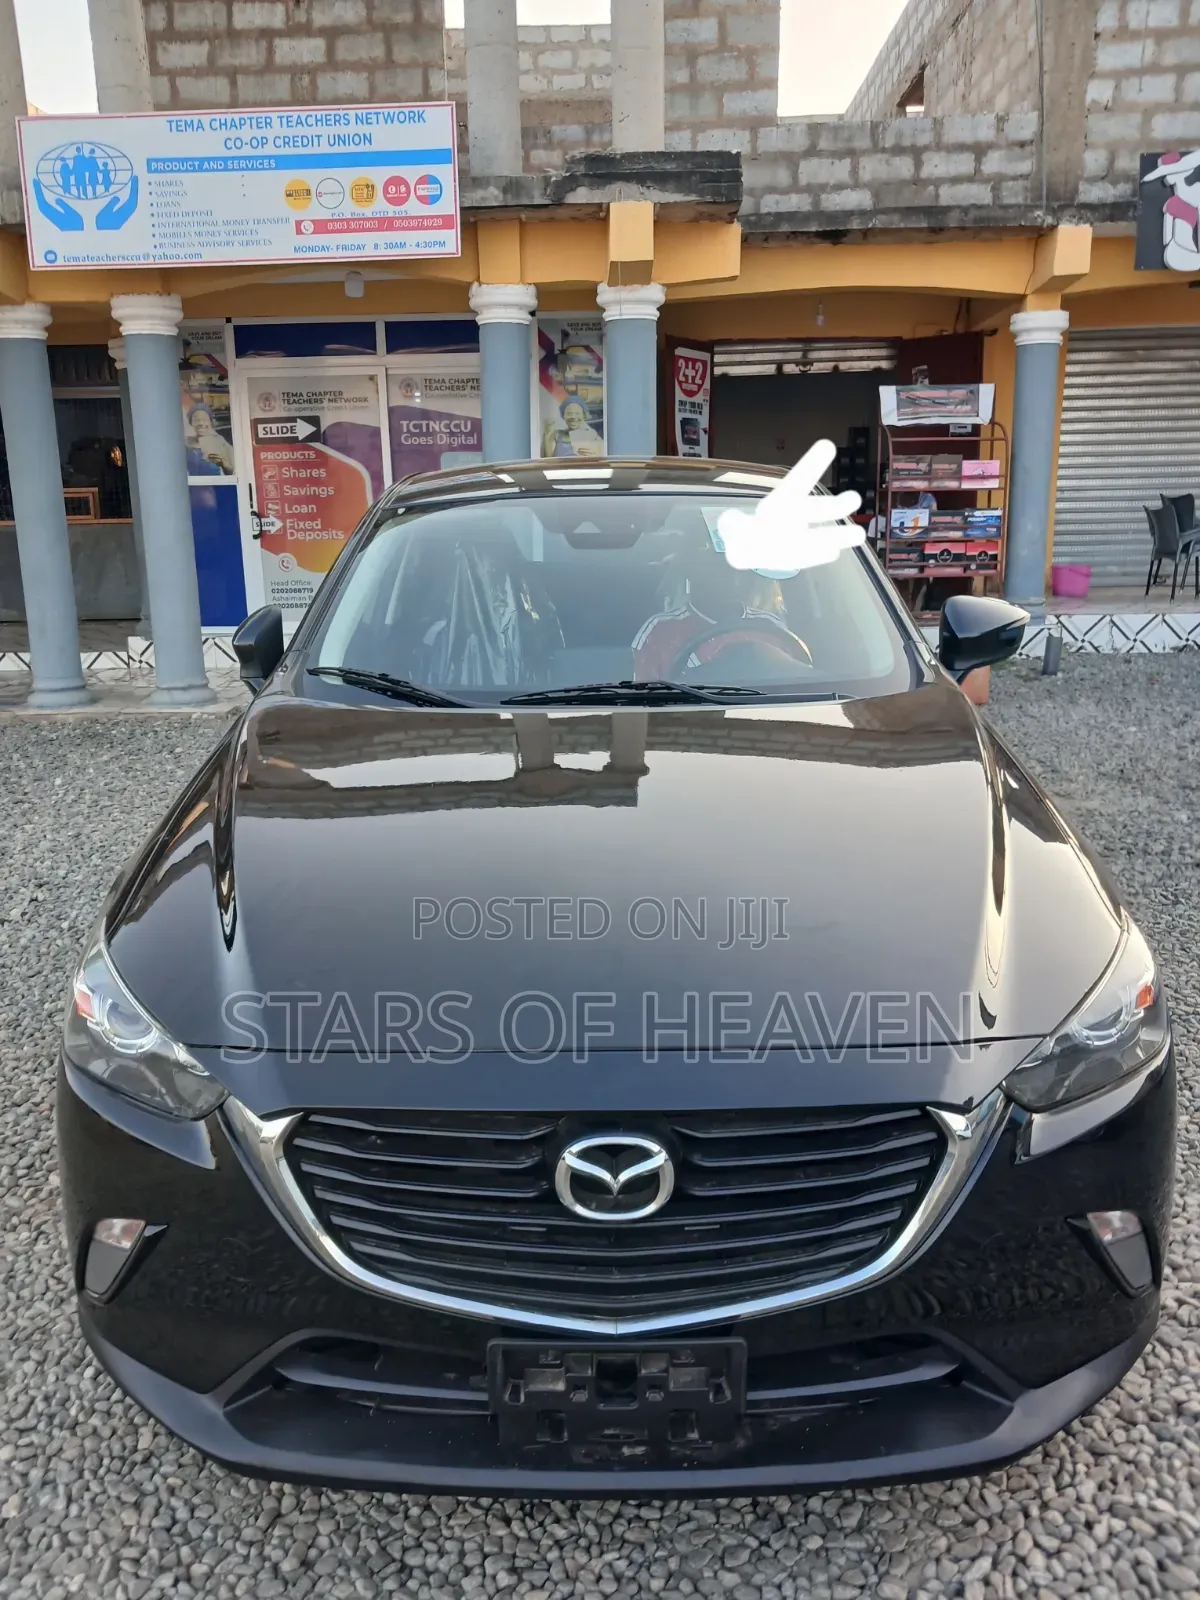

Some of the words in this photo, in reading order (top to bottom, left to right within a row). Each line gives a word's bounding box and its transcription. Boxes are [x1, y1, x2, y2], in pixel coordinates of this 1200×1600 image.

[166, 119, 205, 132] TEMA
[209, 116, 273, 131] CHAPTER
[277, 113, 350, 128] TEACHERS
[355, 110, 426, 126] NETWORK
[224, 136, 268, 150] CO-OP
[273, 135, 322, 148] CREDIT
[328, 133, 372, 147] UNION
[151, 161, 199, 171] PRODUCT
[203, 160, 224, 170] AND
[228, 159, 276, 169] SERVICES
[158, 220, 220, 229] INTERNATIONAL
[253, 217, 290, 225] TRANSFER
[328, 222, 347, 230] 0303
[349, 221, 378, 229] 307003
[159, 241, 195, 249] BUSINESS
[678, 358, 703, 384] 2+2
[263, 425, 297, 435] SLIDE
[400, 420, 471, 433] TCTNCCU
[401, 434, 433, 445] Goes
[437, 433, 477, 447] Digital
[261, 451, 316, 459] PRODUCTS
[281, 467, 327, 478] Shares
[283, 484, 334, 497] Savings
[285, 503, 316, 513] Loan
[286, 518, 321, 529] Fixed
[288, 529, 344, 541] Deposits
